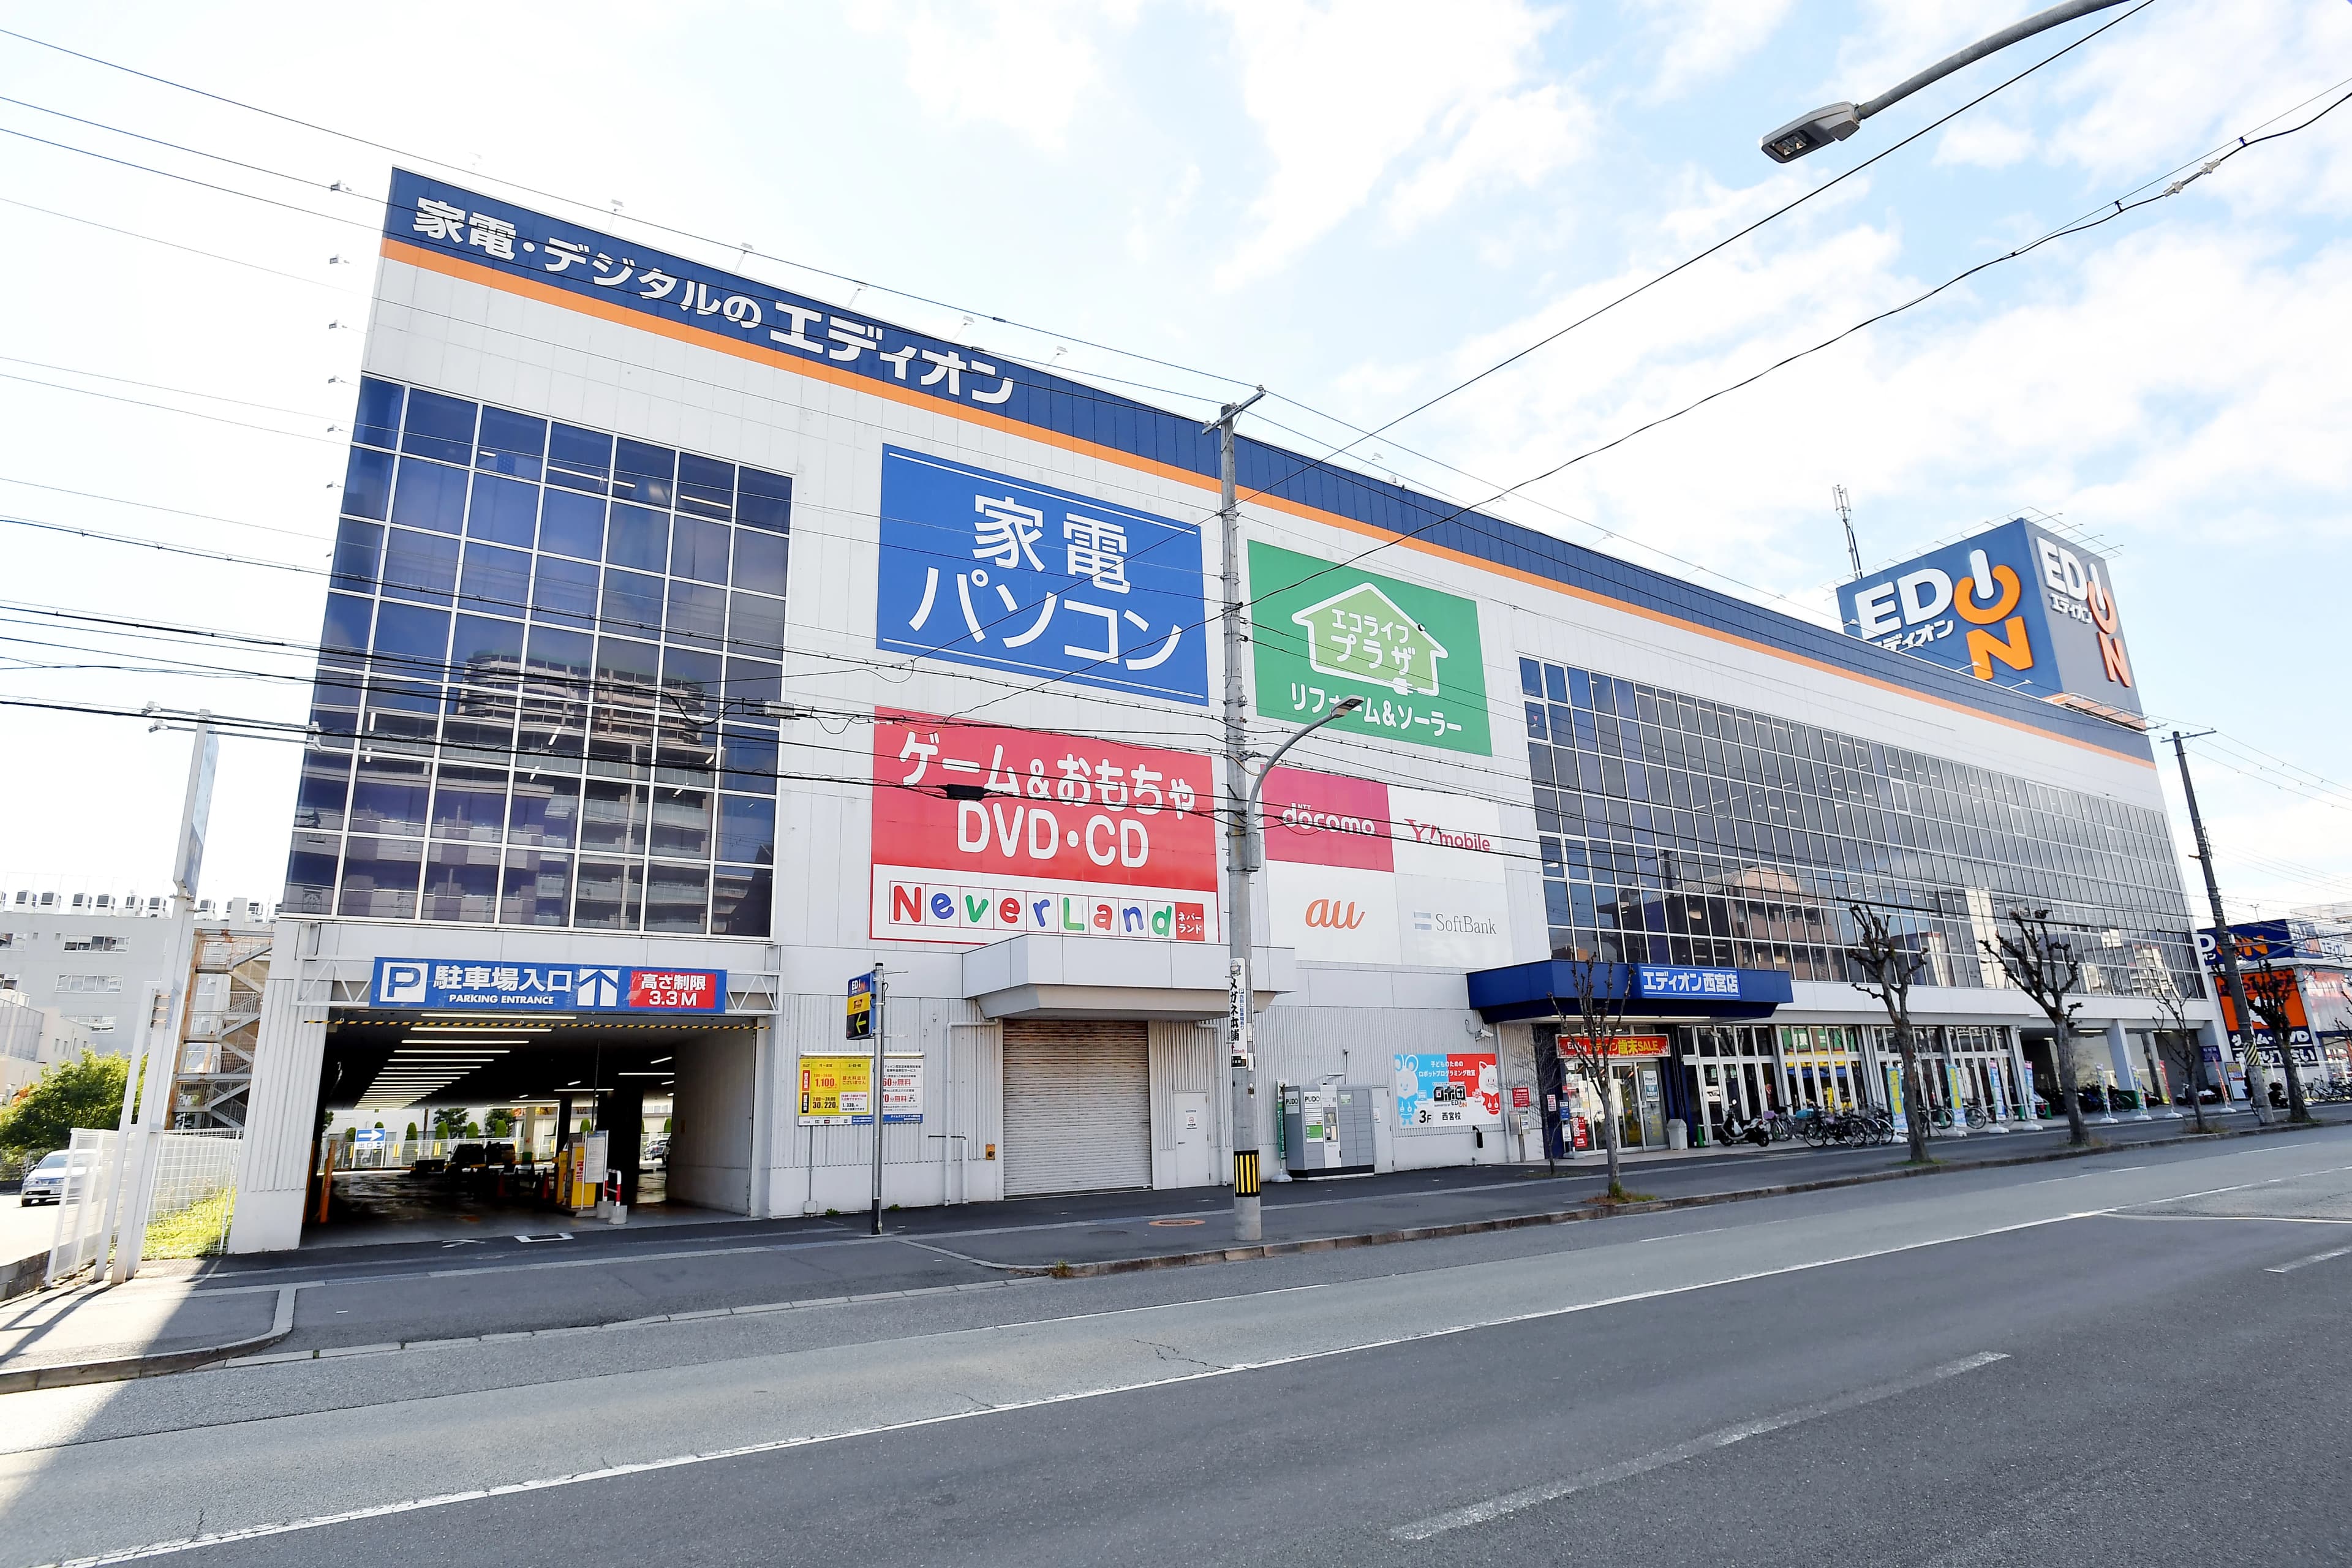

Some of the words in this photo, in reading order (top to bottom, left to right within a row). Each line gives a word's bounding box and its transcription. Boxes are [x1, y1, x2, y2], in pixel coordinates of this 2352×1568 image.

[412, 196, 1014, 405] 家電・デジタルのエディオン
[972, 494, 1131, 594] 家電
[908, 565, 1183, 671] パソコン
[1855, 548, 2034, 680] EDION
[2036, 536, 2132, 687] EDION
[2048, 592, 2094, 624] エディオン
[1331, 608, 1409, 644] エコライフ
[1330, 632, 1416, 676] プラザ
[899, 730, 1196, 820] ゲーム&おもちゃ
[1281, 803, 1376, 835] docomo
[1177, 911, 1202, 922] ネバー
[1177, 922, 1203, 935] ランド
[1305, 899, 1365, 930] au
[1436, 913, 1497, 935] SoftBank
[433, 965, 573, 993] 駐車場入口
[641, 973, 707, 991] 高さ制限
[1642, 970, 1740, 994] エディオン西宮店
[449, 994, 498, 1004] PARKING
[501, 995, 554, 1005] ENTRANCE
[1230, 978, 1240, 1041] メガネ本舗
[883, 1094, 907, 1102] 0分無料
[1419, 1110, 1432, 1123] 3F
[1442, 1112, 1461, 1121] 西宮校
